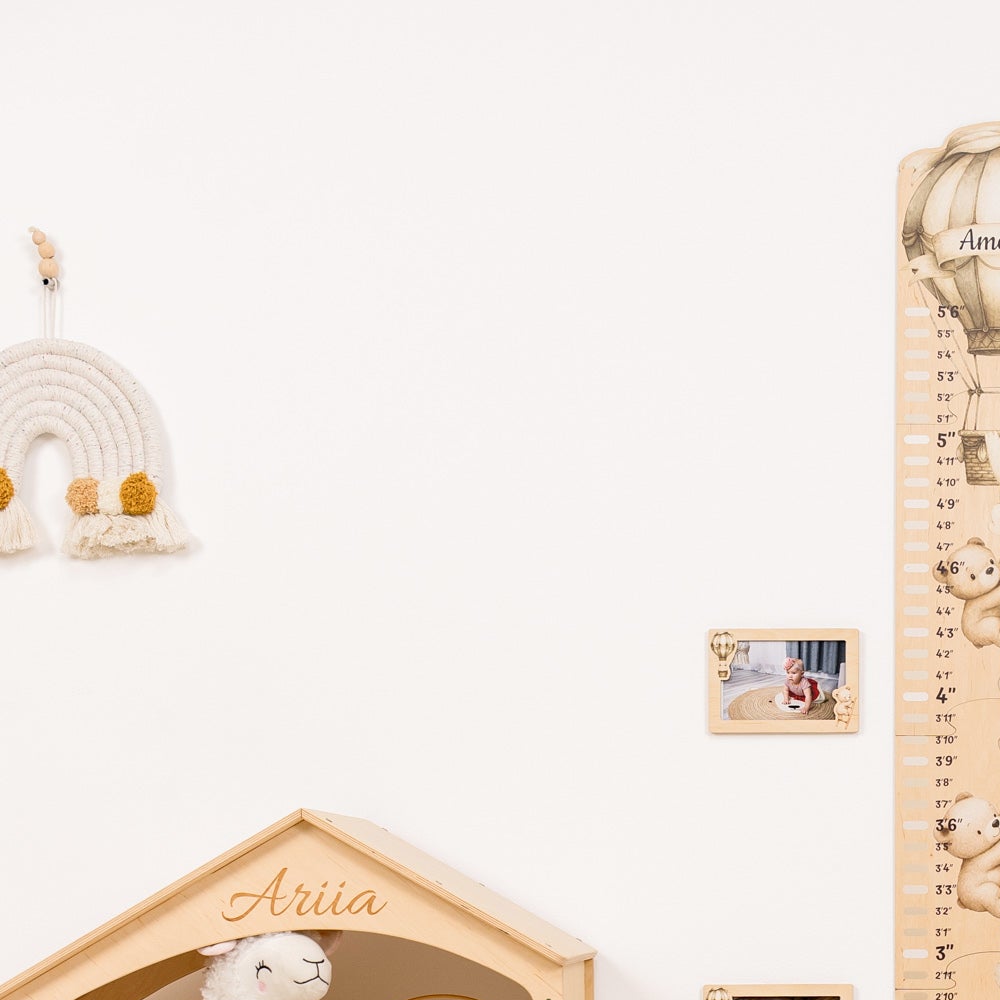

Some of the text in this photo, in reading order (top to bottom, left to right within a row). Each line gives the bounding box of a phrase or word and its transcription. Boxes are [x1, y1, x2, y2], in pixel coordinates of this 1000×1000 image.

[938, 305, 965, 318] 5'6"
[937, 371, 959, 382] 5'3"
[937, 431, 955, 448] 5"
[936, 498, 959, 509] 4'9"
[936, 560, 965, 574] 4'6"
[936, 606, 955, 616] 4'4"
[936, 627, 958, 638] 4'3"
[936, 670, 953, 680] 4'1"
[936, 687, 956, 704] 4"
[936, 755, 958, 767] 3'9"
[936, 818, 962, 831] 3'6"
[222, 867, 388, 922] Ariia
[935, 885, 956, 895] 3'3"
[936, 944, 954, 961] 3"
